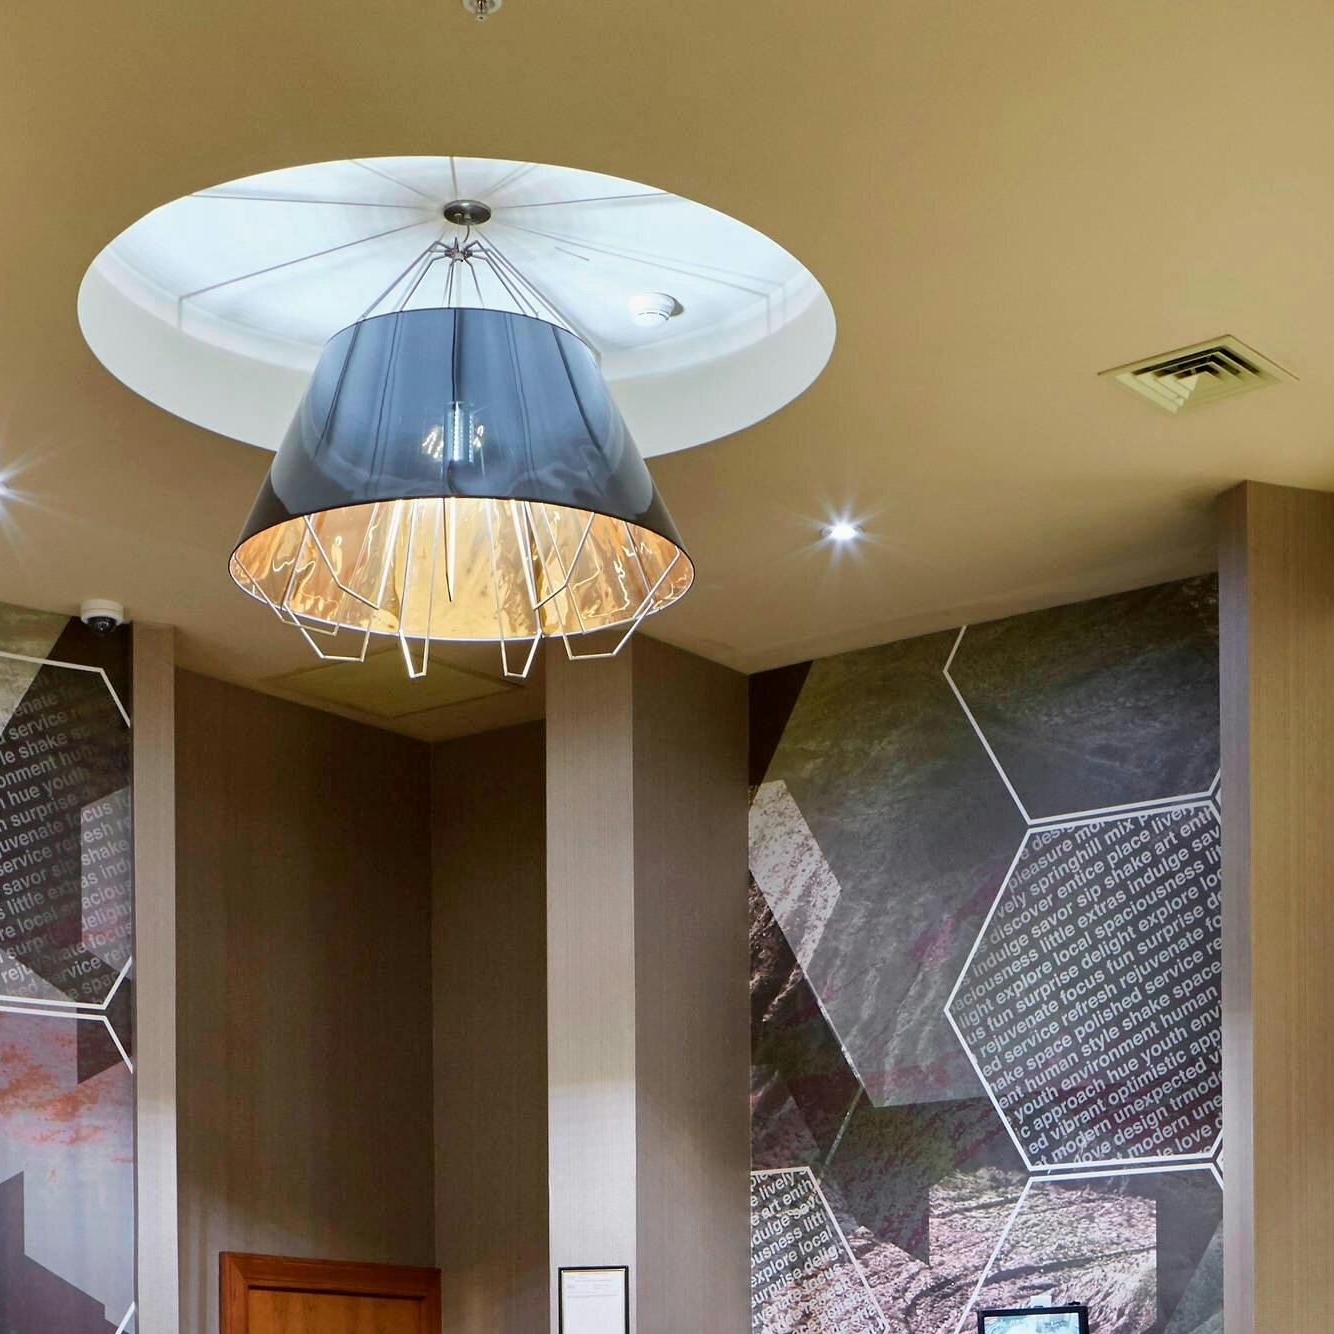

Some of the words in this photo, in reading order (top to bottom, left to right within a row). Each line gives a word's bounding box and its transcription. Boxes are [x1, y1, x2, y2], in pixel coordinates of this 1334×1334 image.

[18, 730, 67, 759] shake
[8, 784, 39, 806] hue
[10, 793, 75, 827] surprise
[2, 869, 45, 896] savor
[989, 892, 1053, 946] discover
[1056, 858, 1103, 900] entice
[1107, 826, 1149, 869] place
[1008, 836, 1071, 894] pleasure
[1030, 832, 1101, 896] springhill
[1104, 816, 1131, 845] mix
[1041, 921, 1074, 954] little
[1077, 887, 1125, 929] extras
[1129, 845, 1189, 896] indulge
[8, 891, 43, 916] little
[973, 931, 1028, 979] indulge
[1031, 900, 1073, 939] savor
[1076, 882, 1100, 909] sip
[1104, 847, 1151, 890] shake
[1154, 826, 1177, 856] art
[995, 958, 1051, 1005] explore
[1054, 926, 1091, 967] local
[1094, 856, 1204, 940] spaciousness
[981, 998, 1057, 1058] rejuvenate
[1060, 967, 1104, 1007] focus
[1107, 948, 1134, 976] fun
[1137, 902, 1204, 956] surprise
[987, 1006, 1013, 1033] fun
[1016, 962, 1078, 1014] surprise
[1081, 921, 1135, 970] delight
[1138, 884, 1197, 933] explore
[1003, 1018, 1059, 1064] service
[1061, 977, 1116, 1027] refresh
[1119, 925, 1203, 990] rejuvenate
[1026, 1049, 1078, 1093] human
[1081, 1023, 1119, 1058] style
[1122, 991, 1170, 1032] shake
[1027, 1032, 1071, 1070] space
[1074, 982, 1141, 1044] polished
[1145, 948, 1203, 995] service
[1015, 1080, 1058, 1125] youth
[1060, 1016, 1158, 1092] environment
[1161, 983, 1217, 1029] human
[1033, 1072, 1104, 1132] approach
[1108, 1055, 1138, 1085] hue
[1141, 1021, 1186, 1068] youth
[1050, 1094, 1105, 1142] vibrant
[1108, 1048, 1186, 1106] optimistic
[1053, 1116, 1111, 1162] modern
[1113, 1053, 1207, 1125] unexpected
[1115, 1104, 1167, 1146] design
[1128, 1112, 1190, 1160] modern
[1176, 1119, 1217, 1155] love
[761, 1169, 794, 1201] lively
[763, 1195, 780, 1219] art
[750, 1248, 797, 1287] explore
[799, 1221, 833, 1257] local
